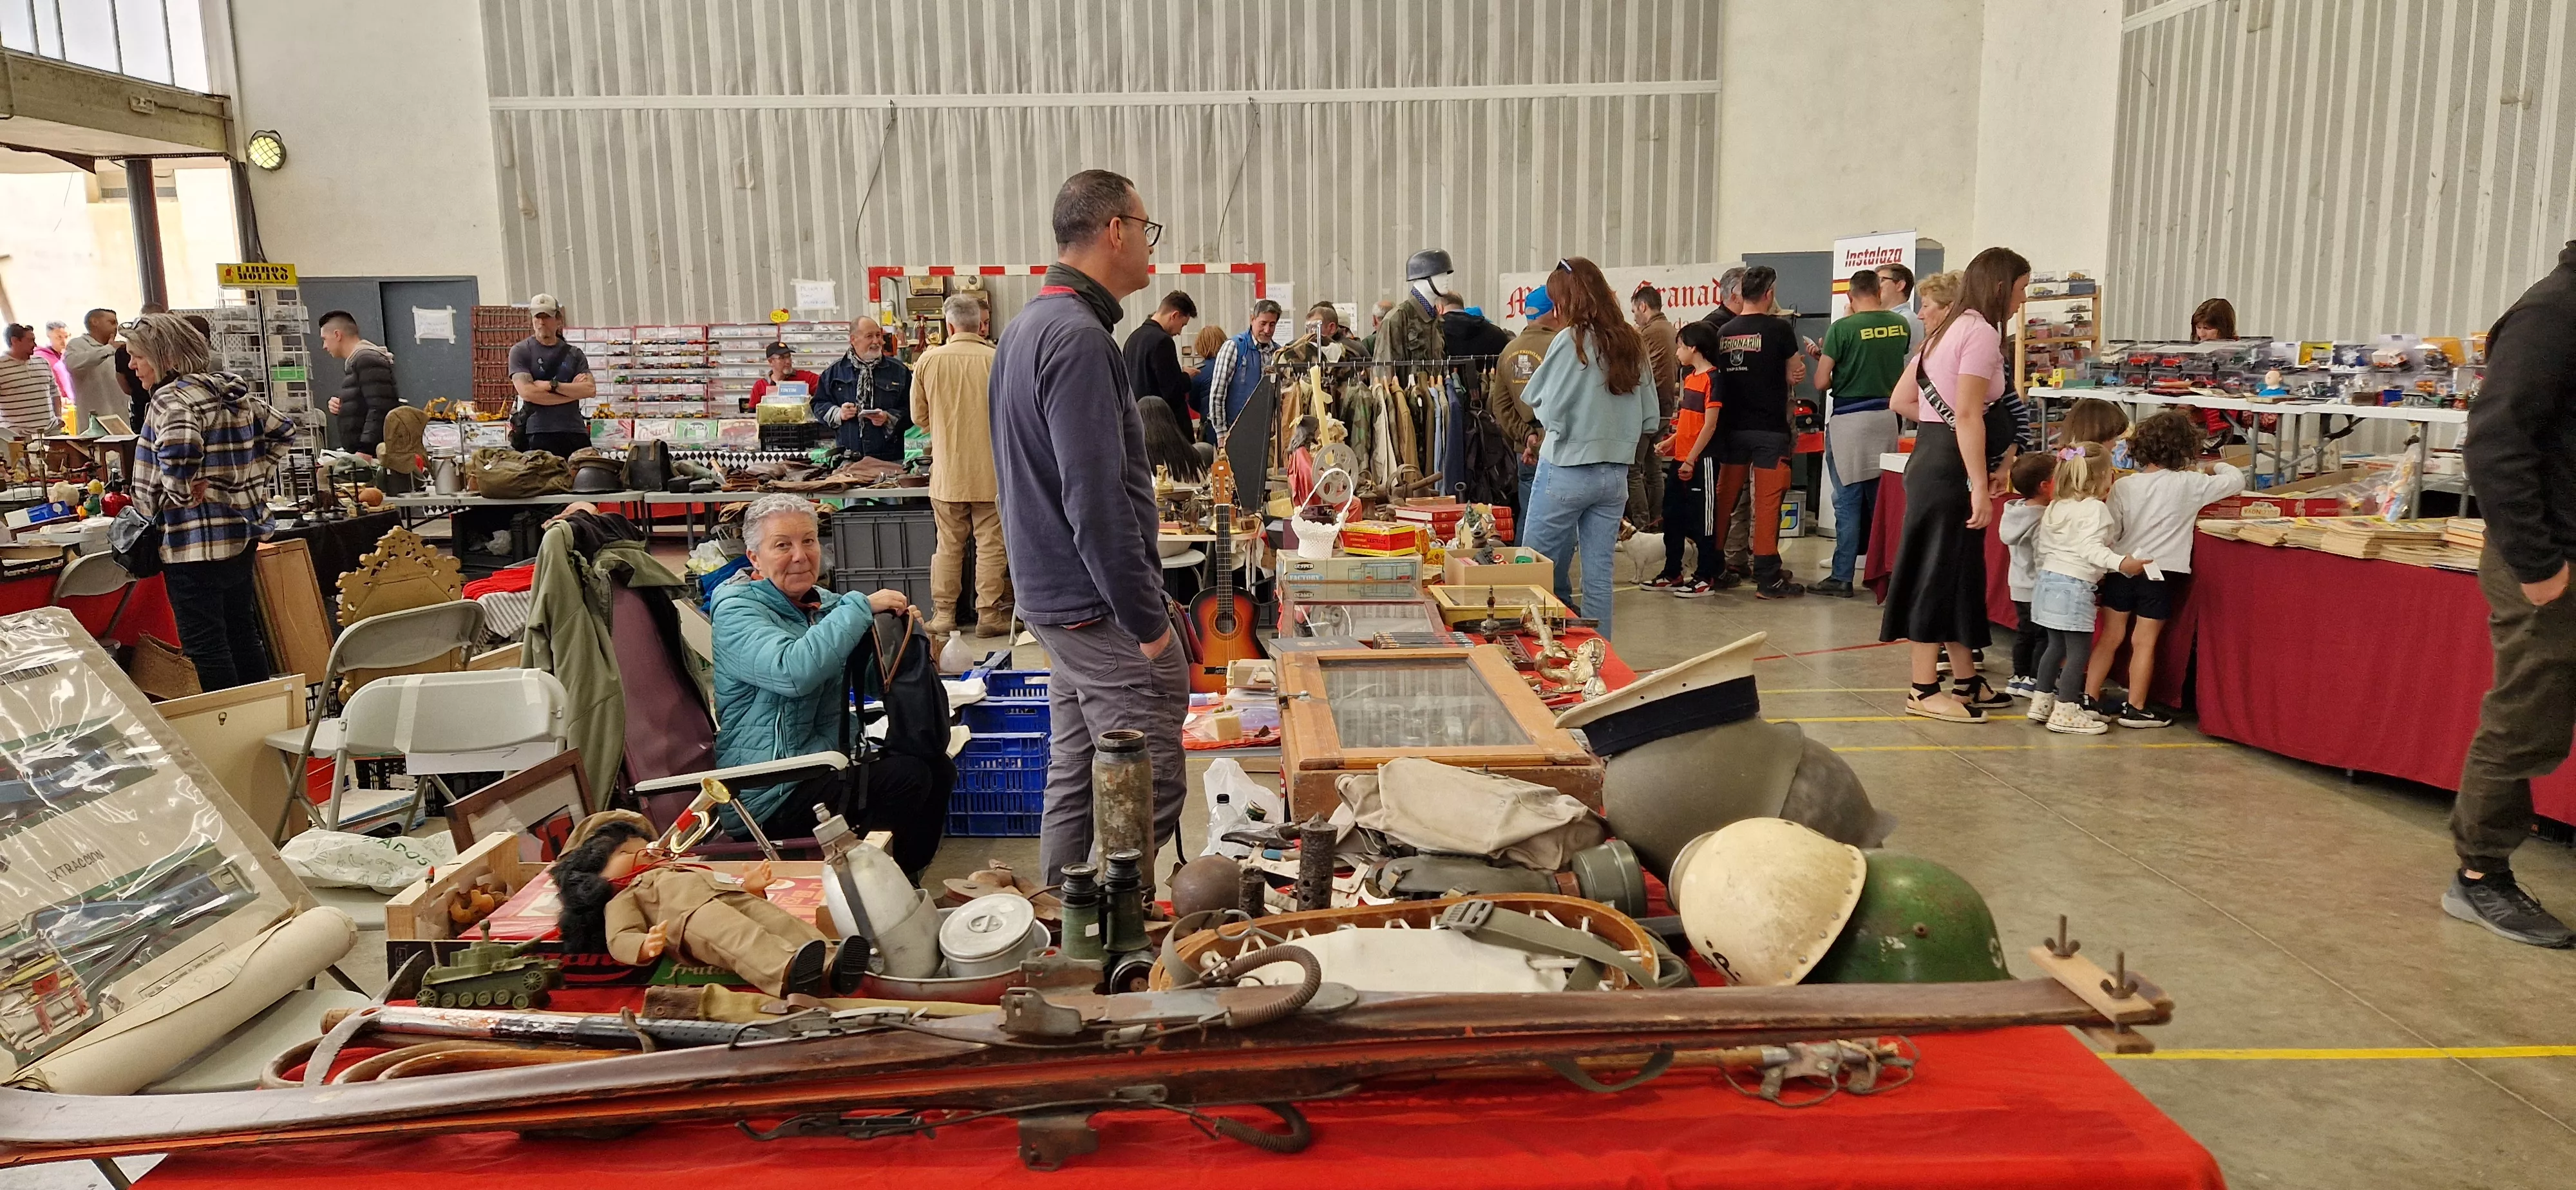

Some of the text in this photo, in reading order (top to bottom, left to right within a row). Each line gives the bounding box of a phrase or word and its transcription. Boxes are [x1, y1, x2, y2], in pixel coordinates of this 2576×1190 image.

[1845, 247, 1902, 267] Instalaza
[1860, 325, 1908, 340] BOEL
[46, 849, 106, 882] EXTRACCION
